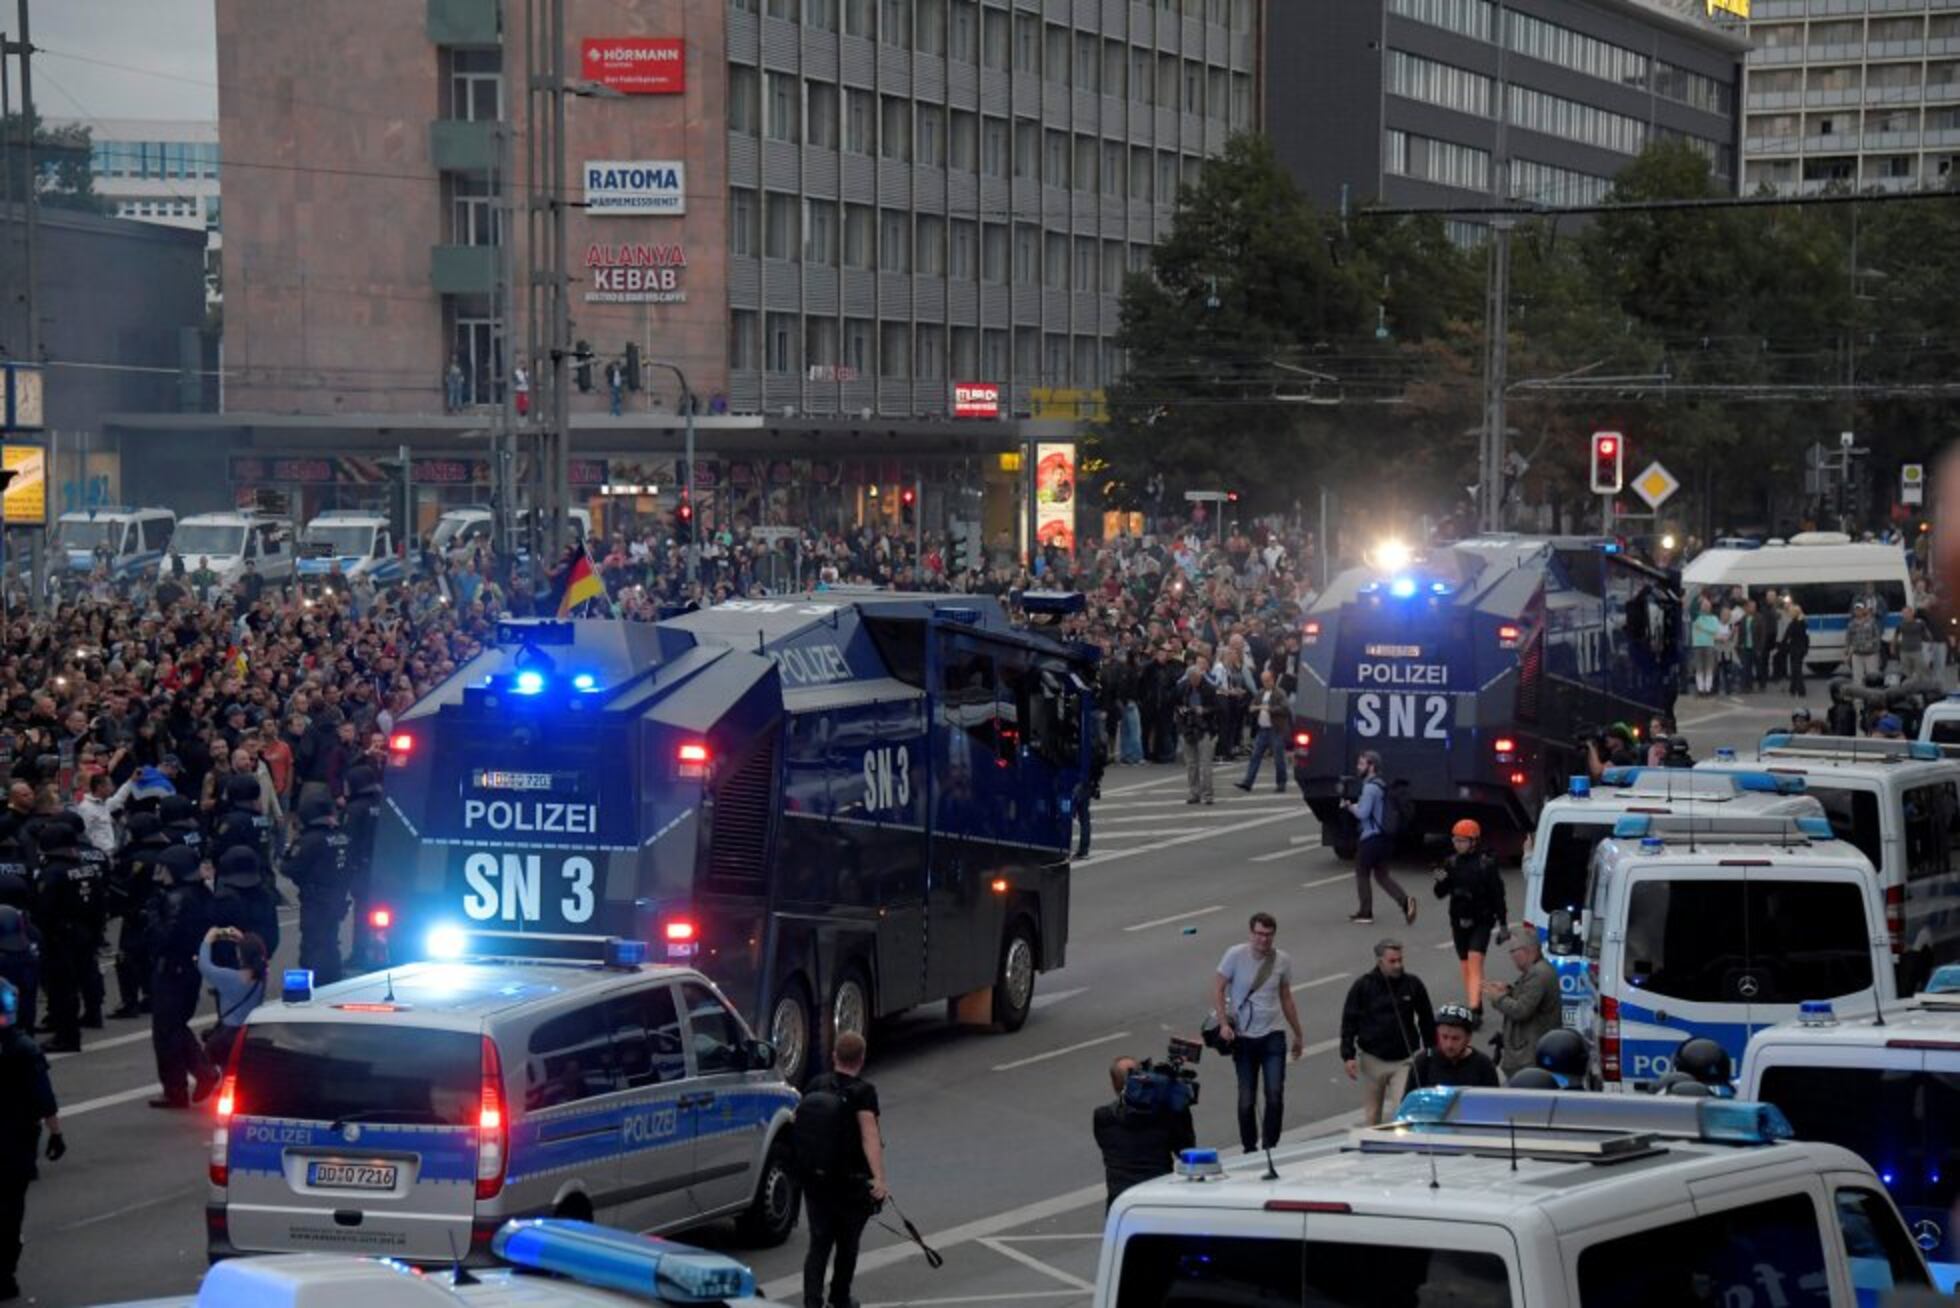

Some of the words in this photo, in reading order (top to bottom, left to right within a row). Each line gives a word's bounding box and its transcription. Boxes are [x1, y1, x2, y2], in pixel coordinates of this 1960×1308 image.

[603, 46, 679, 61] HÖRMANN
[589, 169, 678, 189] RATOMA
[585, 242, 687, 267] ALANYA
[594, 268, 676, 290] KEBAB
[768, 643, 854, 687] POLIZEI
[1358, 663, 1447, 685] POLIZEI
[864, 747, 893, 813] SN
[897, 745, 910, 807] 3
[465, 800, 598, 833] POLIZEI
[463, 852, 541, 921] SN
[561, 855, 595, 923] 3
[245, 1125, 312, 1145] POLIZEI
[624, 1108, 677, 1144] POLIZEI
[358, 1168, 392, 1185] 7216
